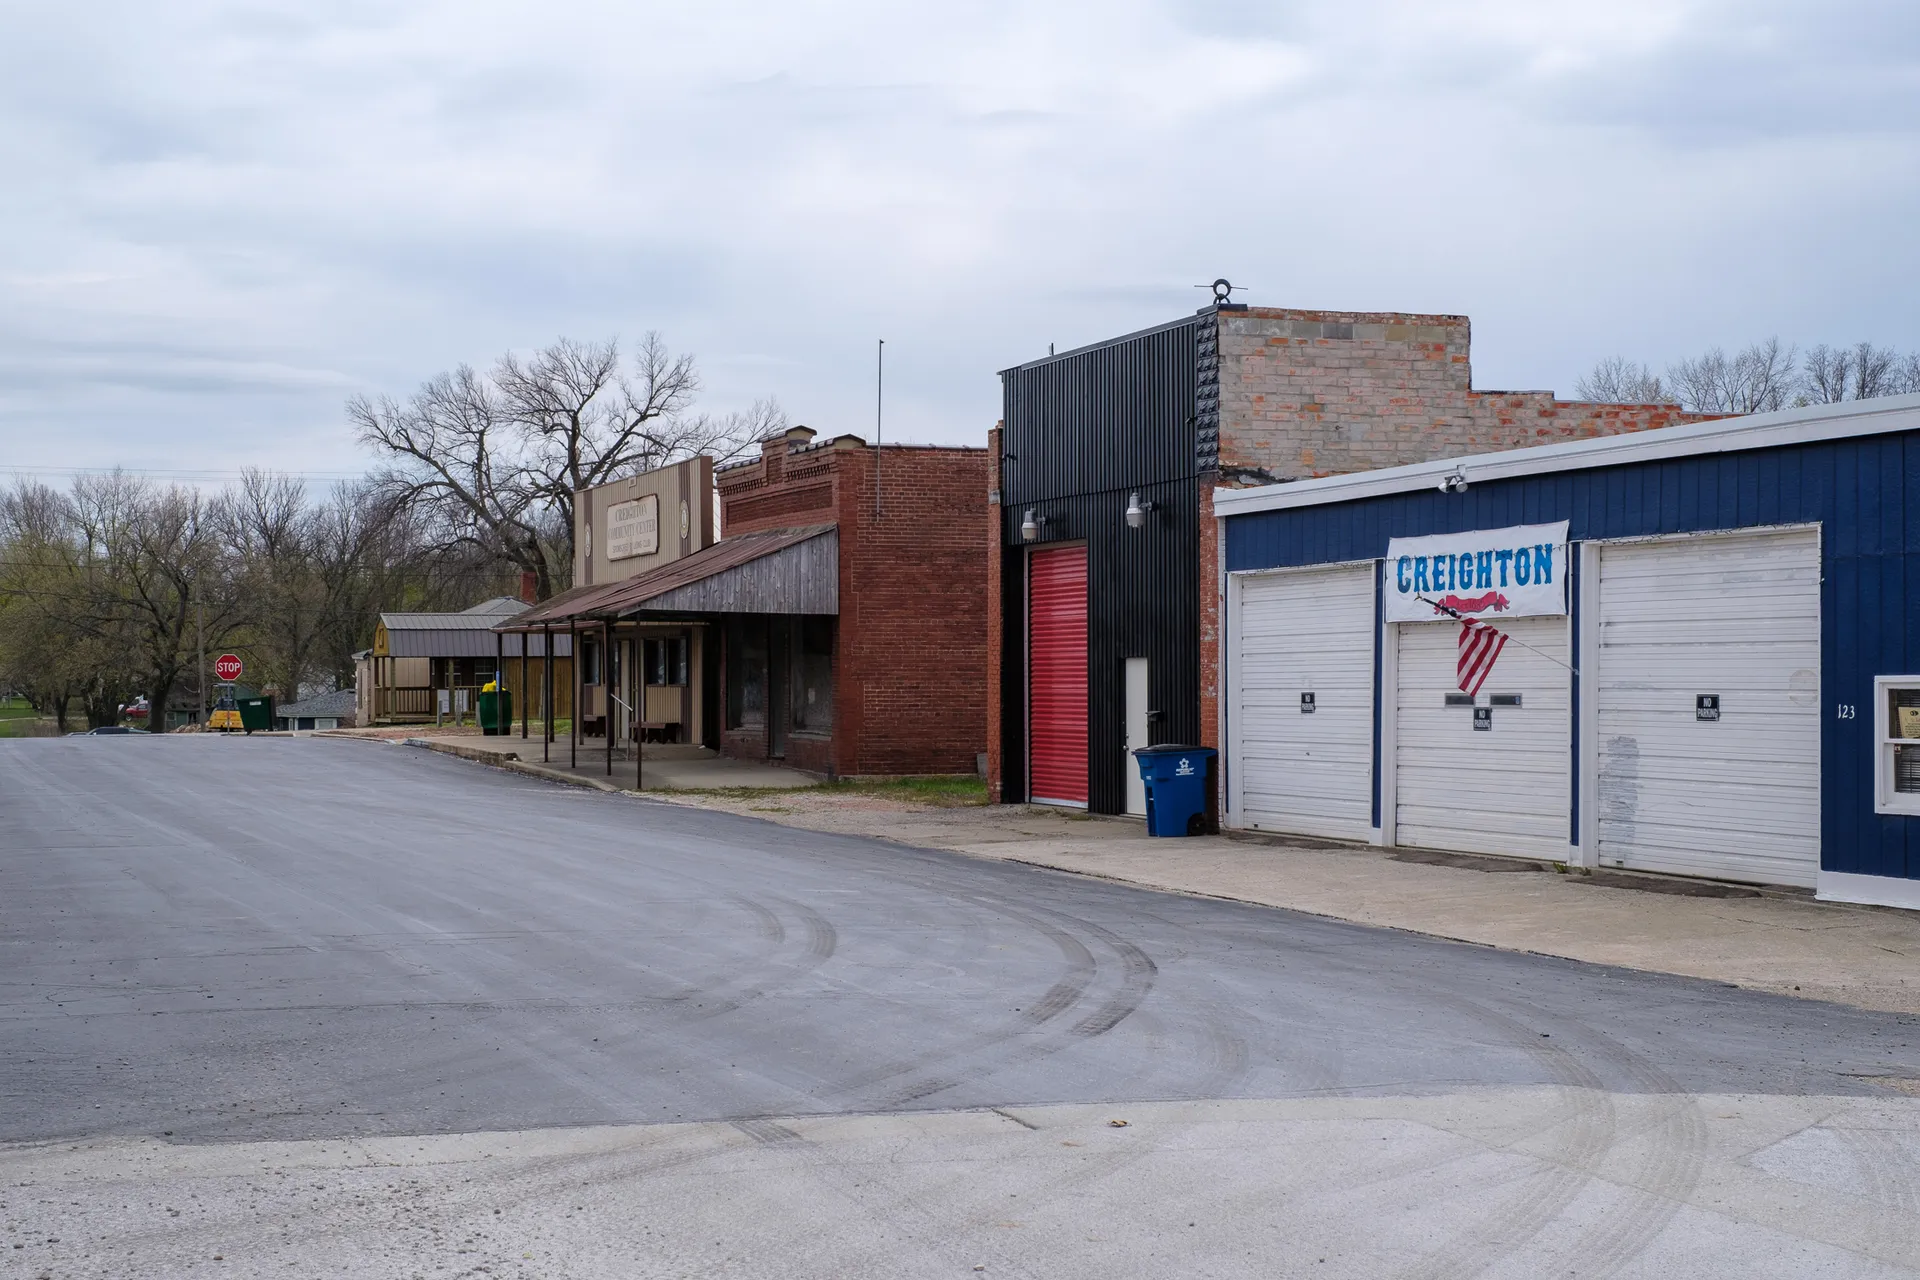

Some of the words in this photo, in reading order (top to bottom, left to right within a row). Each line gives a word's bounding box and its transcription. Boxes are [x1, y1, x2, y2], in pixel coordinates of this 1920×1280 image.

[1397, 543, 1553, 593] CREIGHTON
[217, 662, 241, 672] STOP
[1703, 697, 1711, 707] NO
[1697, 708, 1718, 717] PARKING
[1837, 703, 1855, 719] 123
